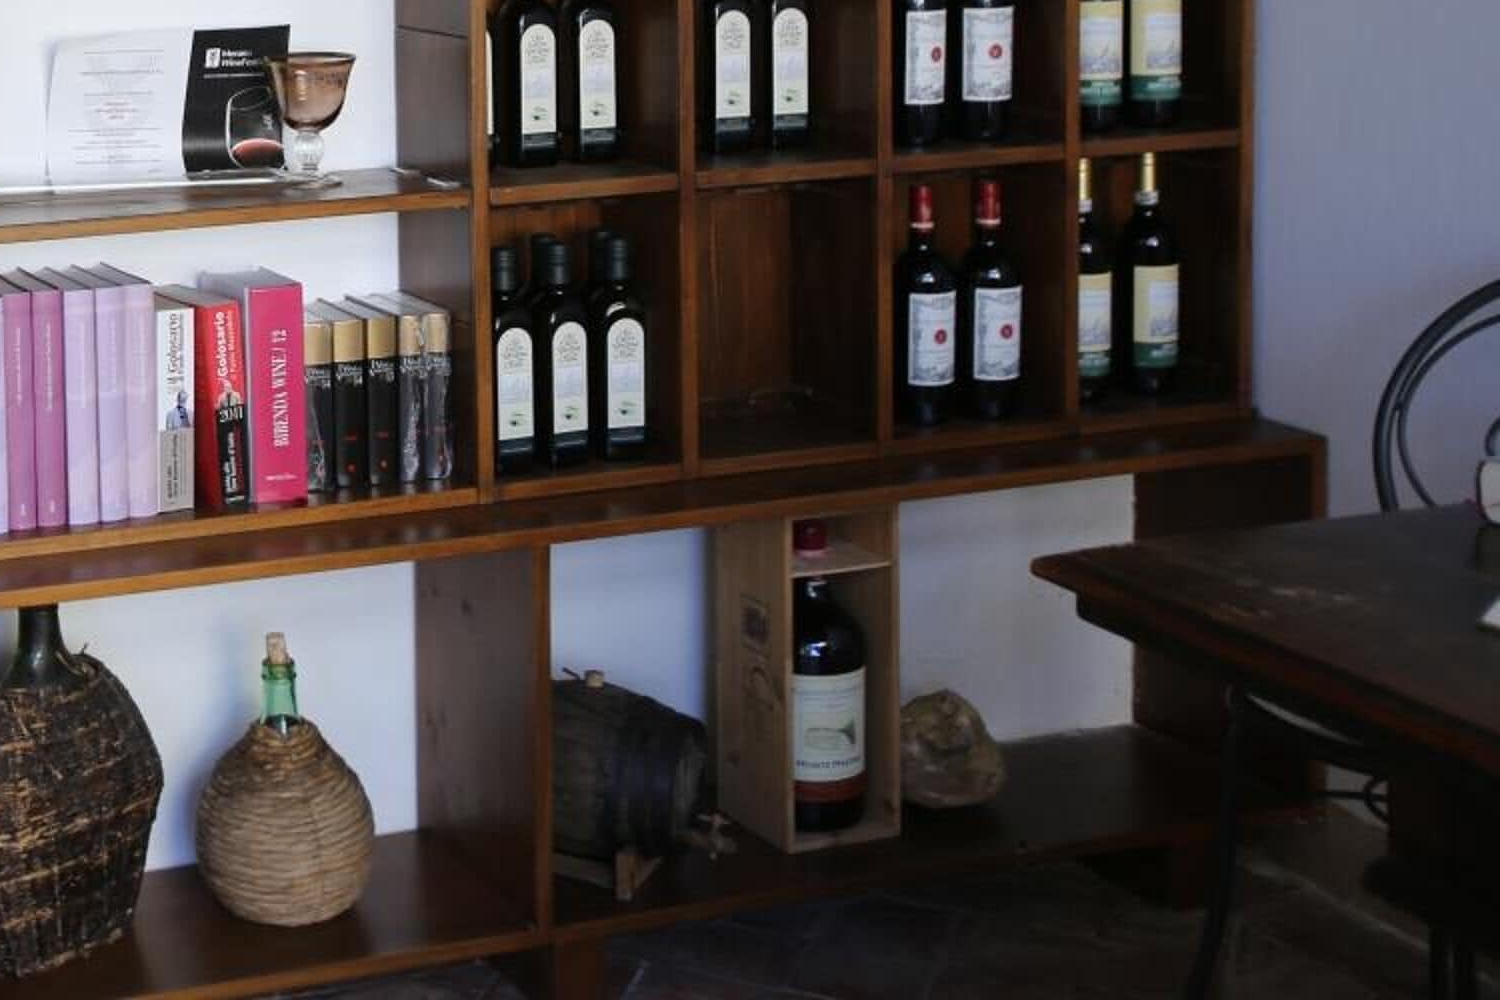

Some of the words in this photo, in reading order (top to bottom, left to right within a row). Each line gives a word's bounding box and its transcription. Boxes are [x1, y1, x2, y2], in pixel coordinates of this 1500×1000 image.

[214, 311, 228, 377] Golosario
[271, 354, 288, 389] WINE
[273, 390, 289, 449] BIBENDA
